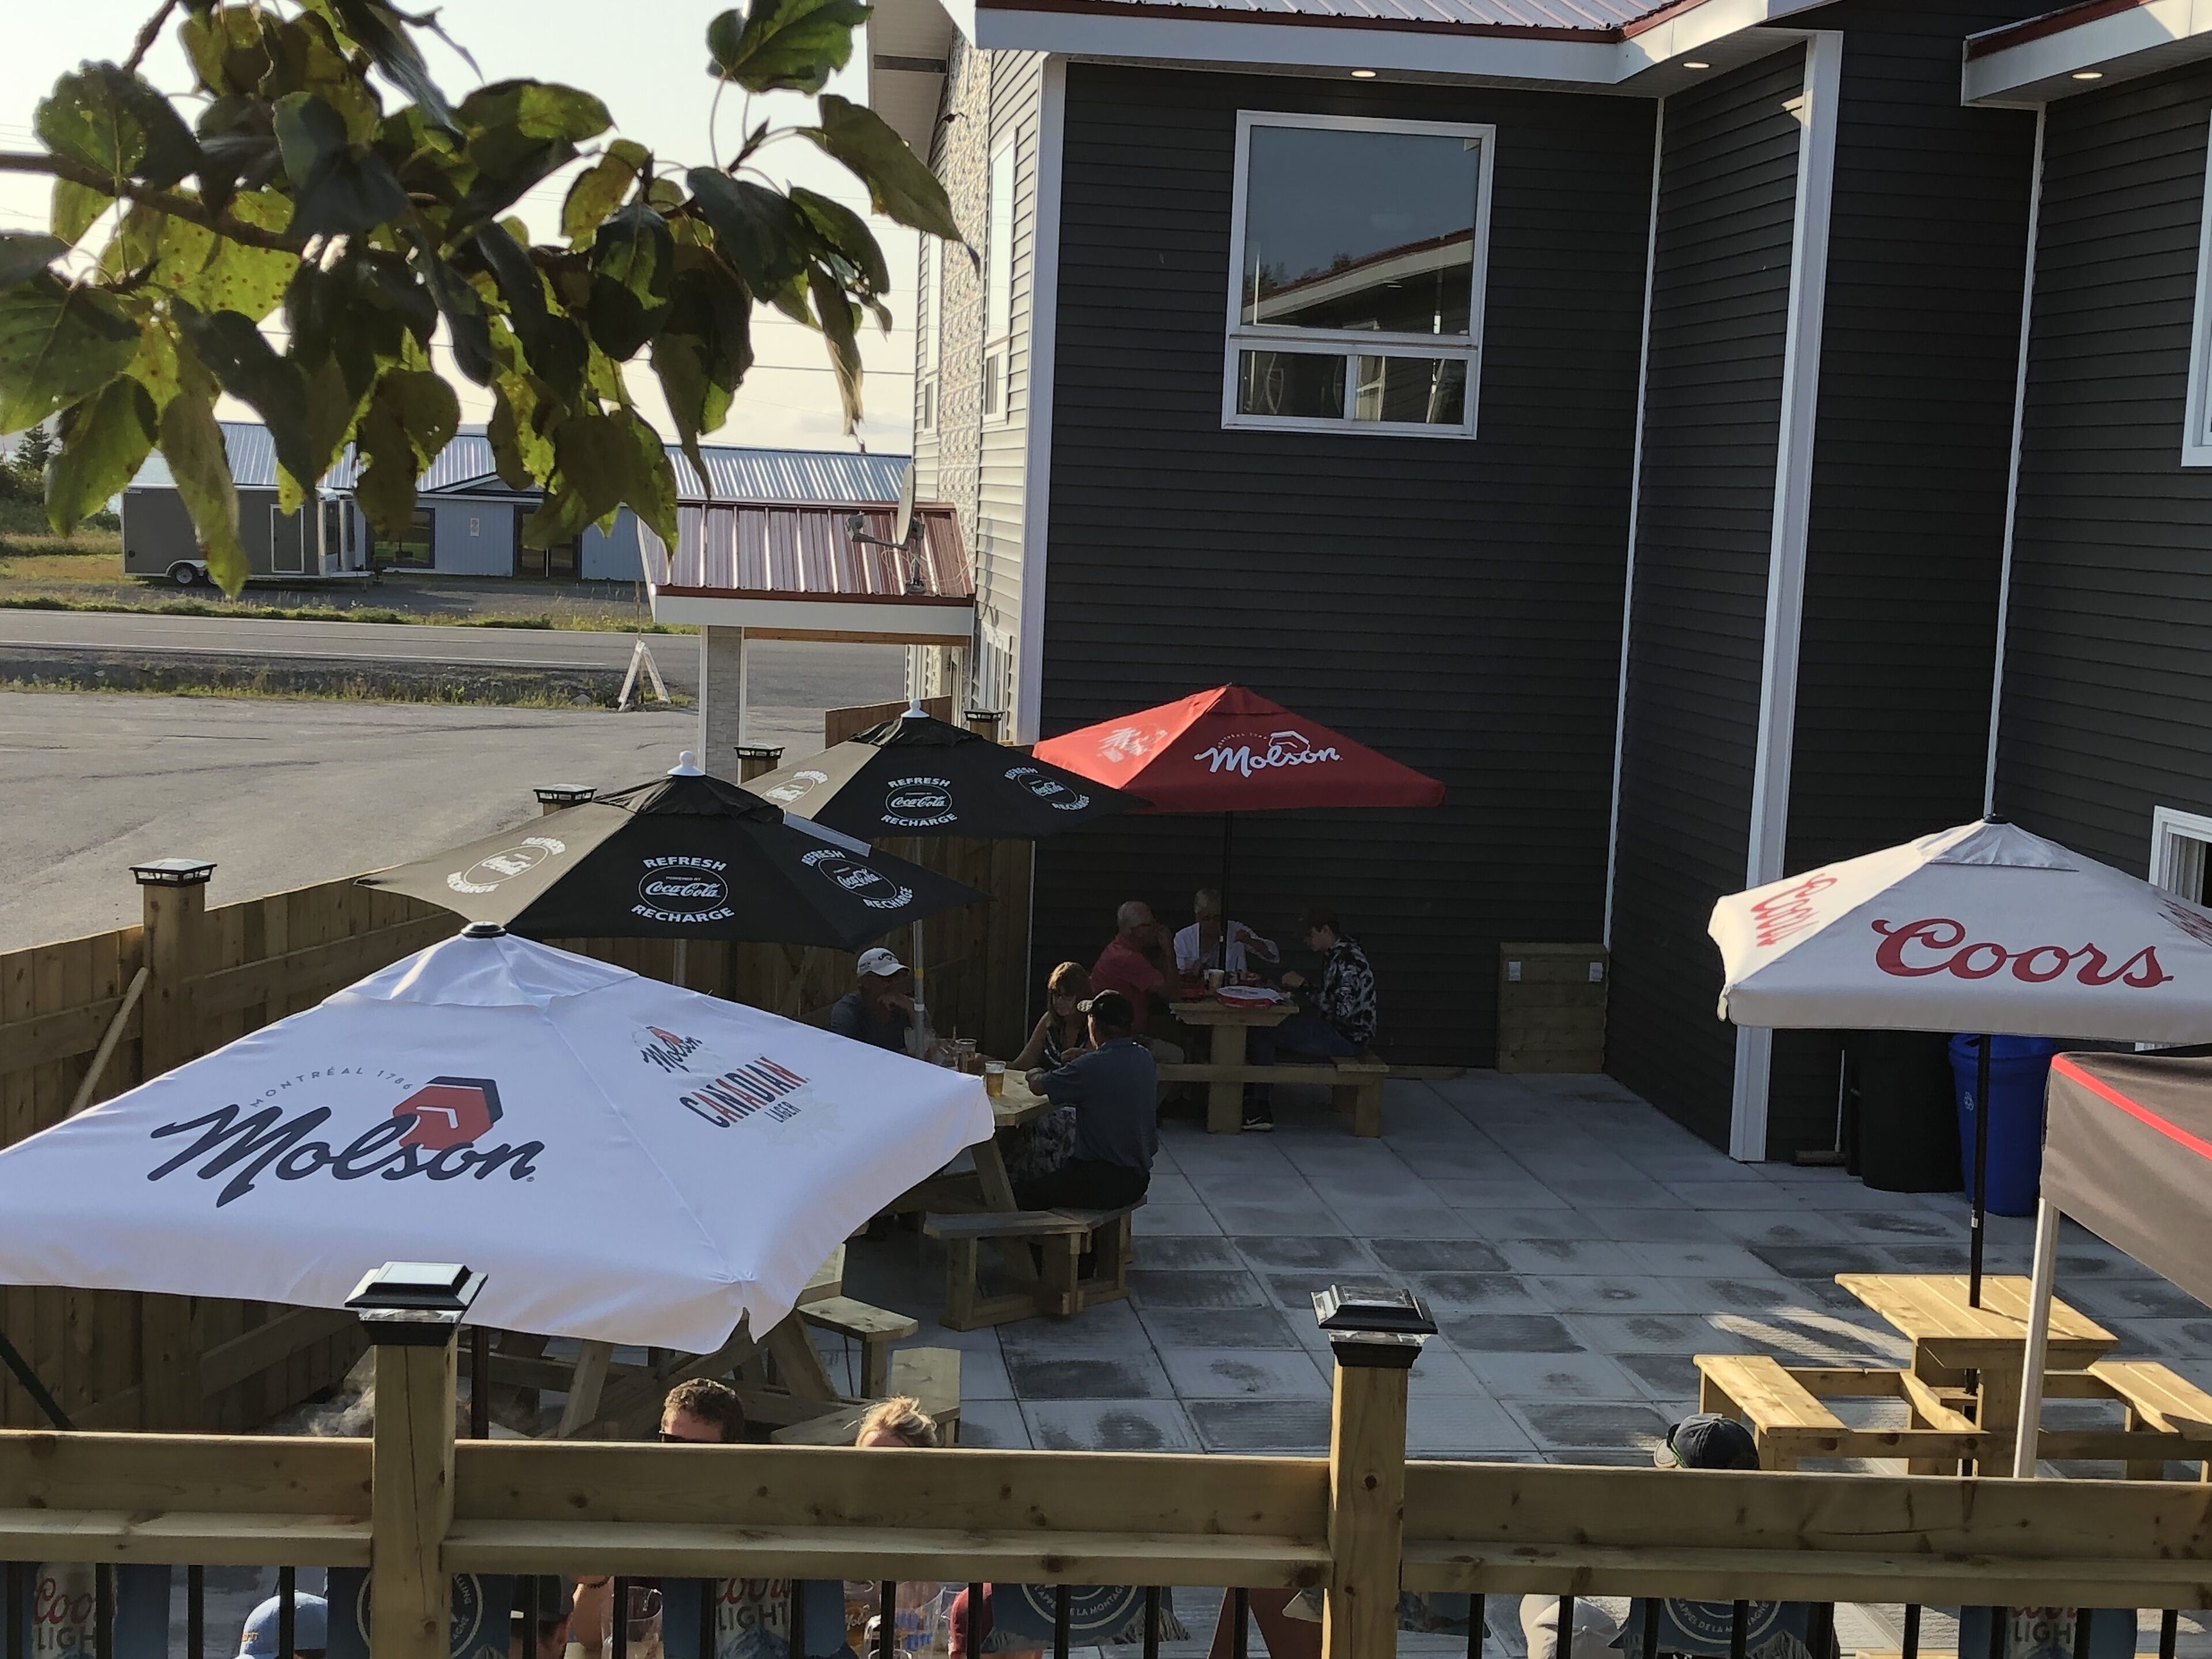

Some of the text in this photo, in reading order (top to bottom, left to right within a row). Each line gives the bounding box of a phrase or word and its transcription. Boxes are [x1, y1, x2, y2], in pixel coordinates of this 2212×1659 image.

[1194, 746, 1340, 778] Molson
[888, 777, 950, 787] REFRESH
[881, 813, 958, 827] RECHARGE
[643, 857, 727, 871] REFRESH
[801, 850, 846, 866] REFRESH
[863, 886, 912, 908] RECHARGE
[631, 904, 734, 923] RECHARGE
[1872, 918, 2174, 988] Coors
[640, 1036, 703, 1073] Molson
[250, 1067, 413, 1107] MONTRÉAL 1786
[679, 1056, 808, 1127] CANADIAN
[764, 1101, 801, 1123] LAGER
[146, 1104, 545, 1208] Molson
[33, 1578, 114, 1624] Coo
[718, 1602, 788, 1630] LIGHT
[38, 1627, 97, 1650] LIGH
[2014, 1621, 2070, 1644] LIGH
